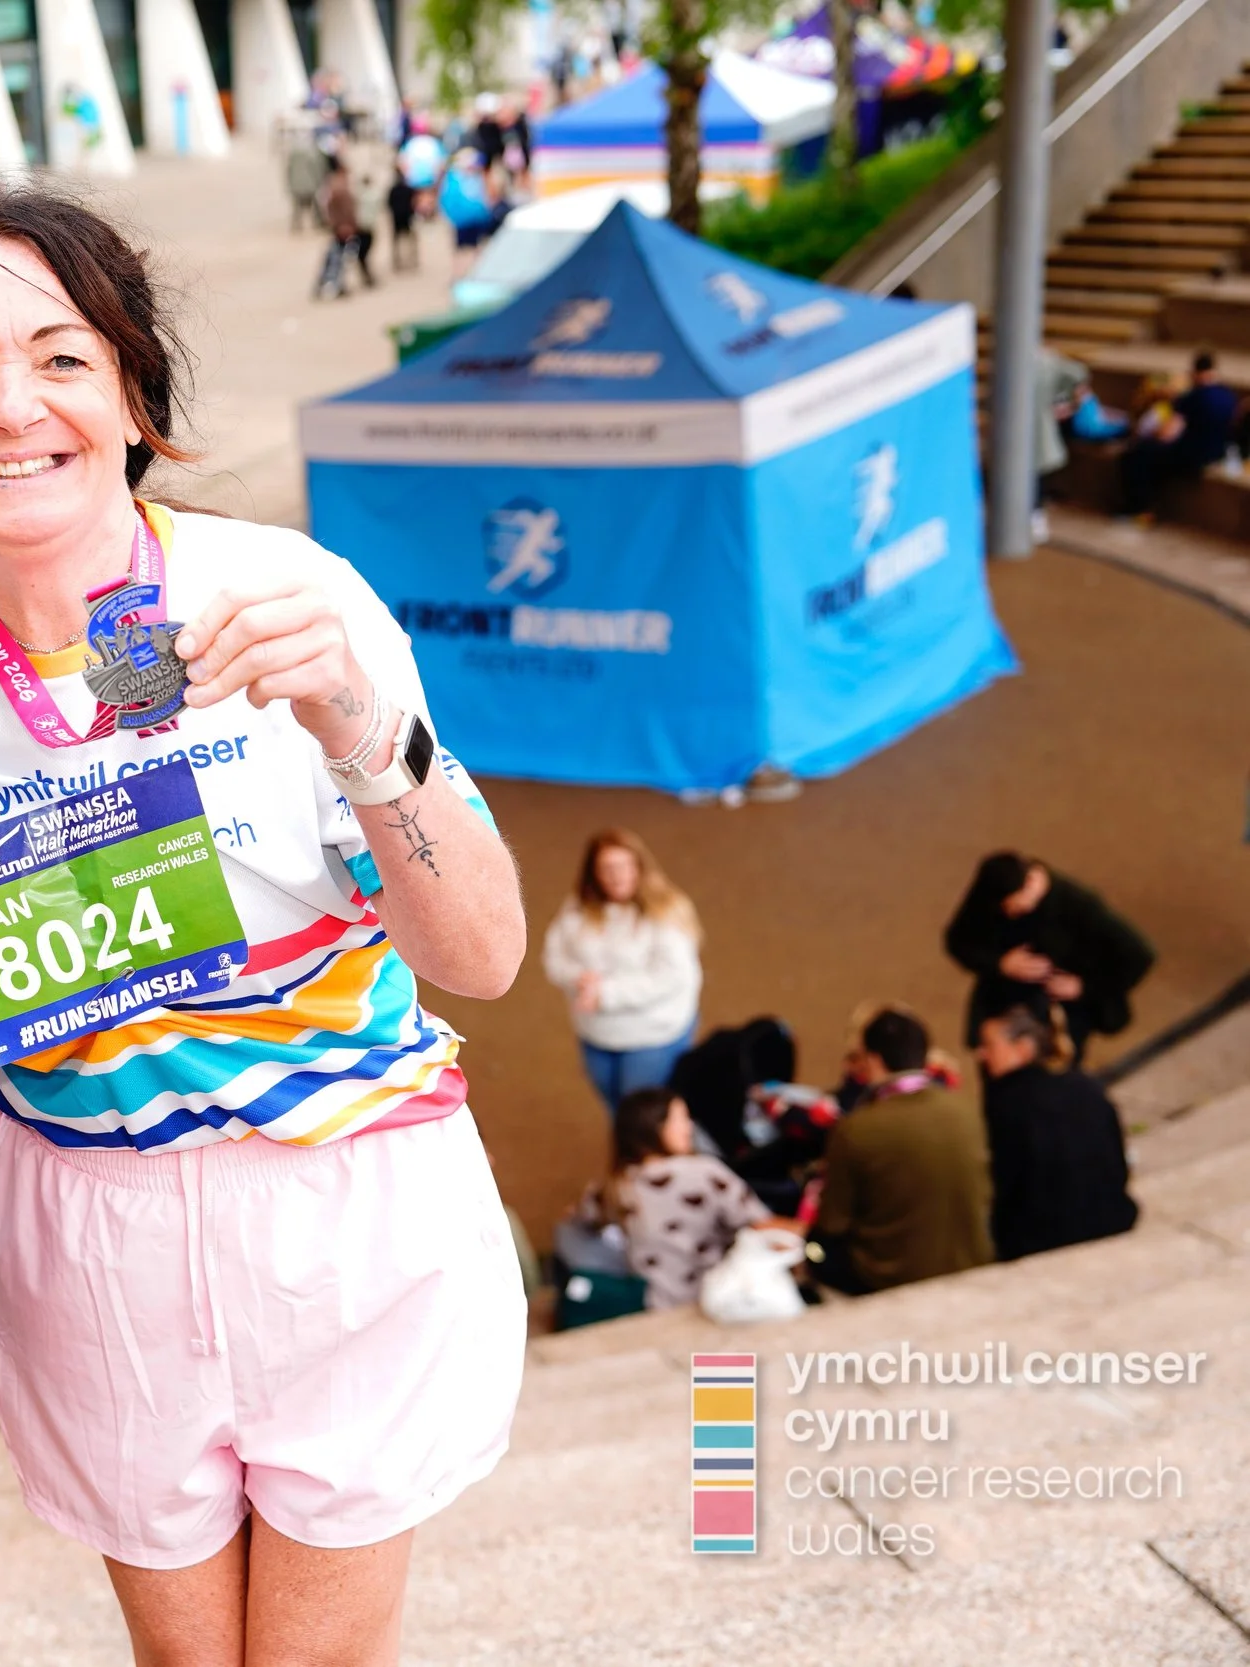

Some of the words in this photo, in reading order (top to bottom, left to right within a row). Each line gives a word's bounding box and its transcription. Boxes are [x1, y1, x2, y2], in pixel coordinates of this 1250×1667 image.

[3, 662, 37, 703] 2026
[151, 688, 176, 705] 2026
[30, 787, 132, 838] SWANSEA
[40, 847, 69, 864] HANNER
[69, 835, 103, 853] MARATHON
[103, 823, 139, 841] ABERTAWE
[157, 831, 204, 857] CANCER
[112, 861, 171, 889] RESEARCH
[169, 847, 209, 875] WALES
[19, 968, 198, 1049] #RUNSWANSEA
